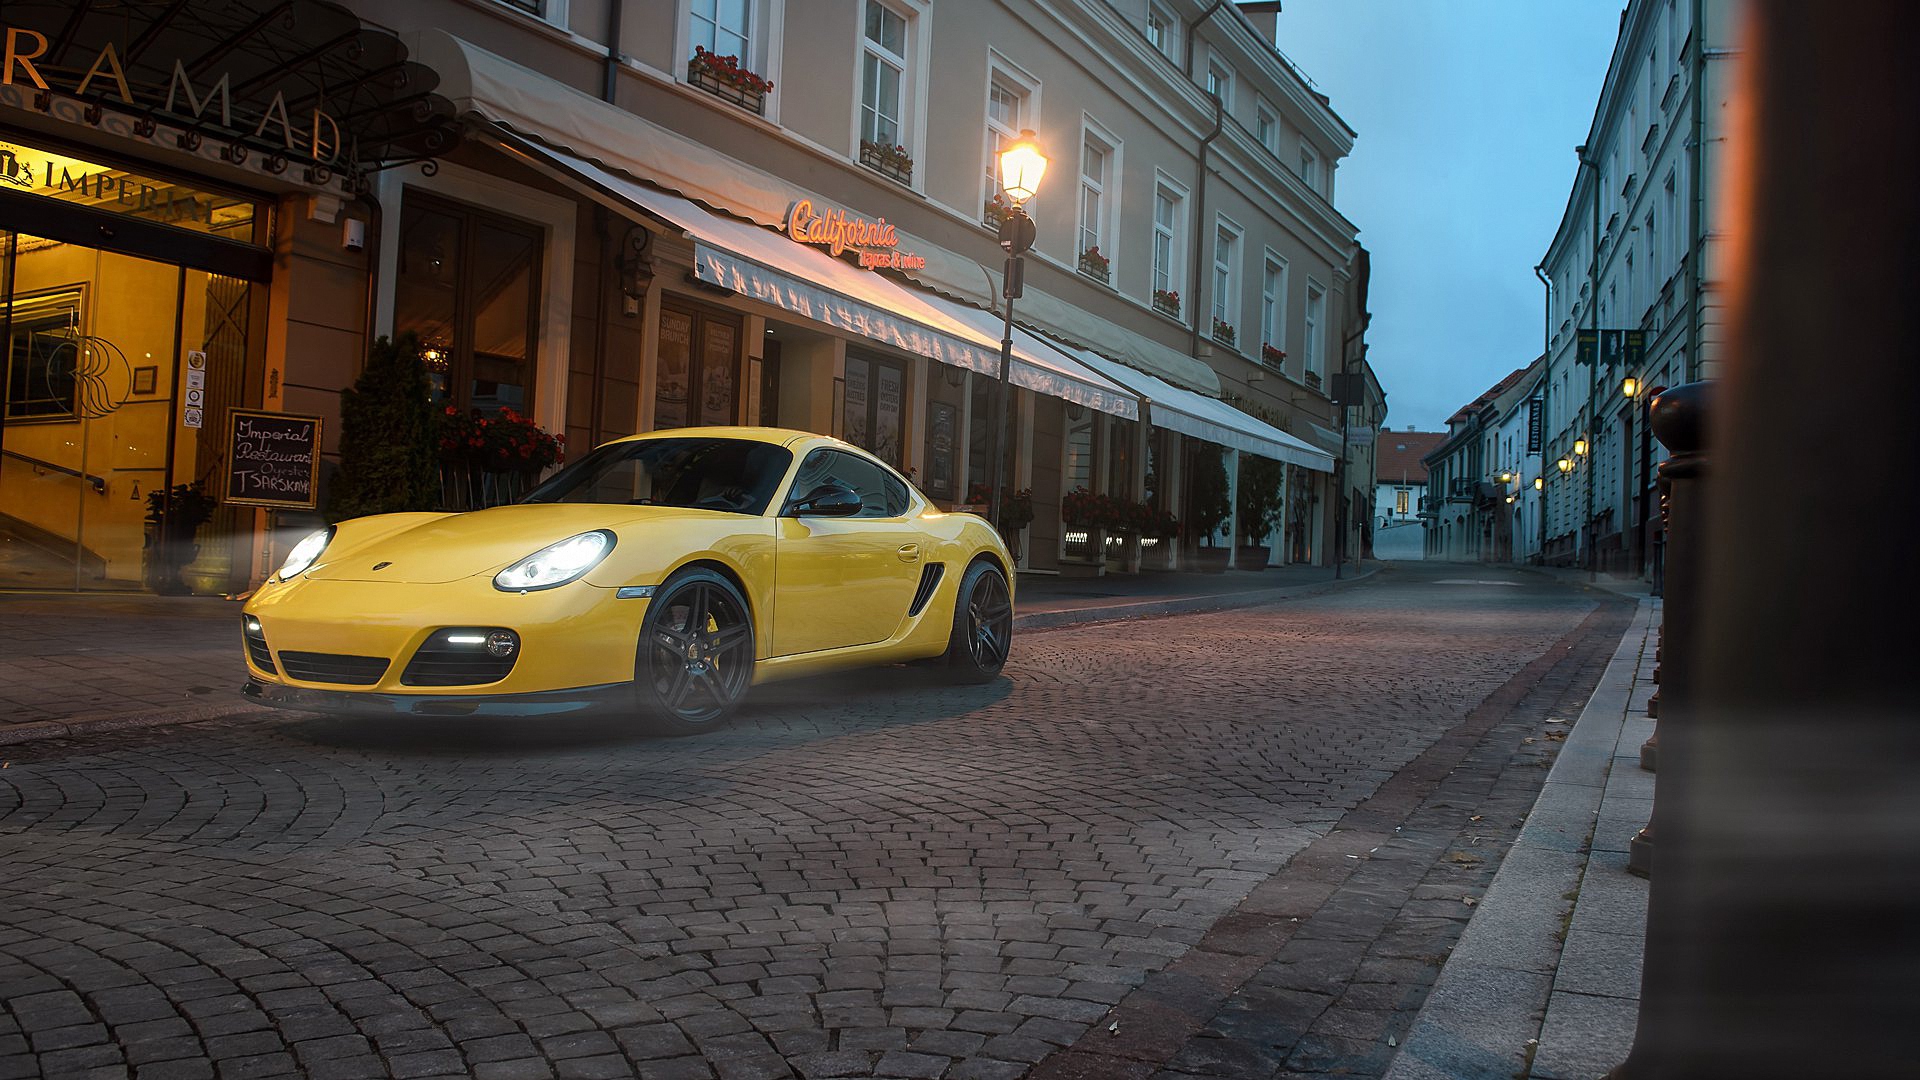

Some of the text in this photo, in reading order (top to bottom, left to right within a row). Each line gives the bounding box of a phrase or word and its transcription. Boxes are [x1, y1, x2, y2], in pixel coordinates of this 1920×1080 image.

[45, 160, 218, 226] IMPERIAL
[789, 199, 899, 256] California
[860, 250, 891, 271] tapas
[660, 328, 689, 345] BRUNCH
[661, 315, 689, 332] SUNDAY
[236, 419, 310, 451] Imperial
[1530, 402, 1540, 449] RESTORANAS
[235, 442, 313, 464] Restaurant
